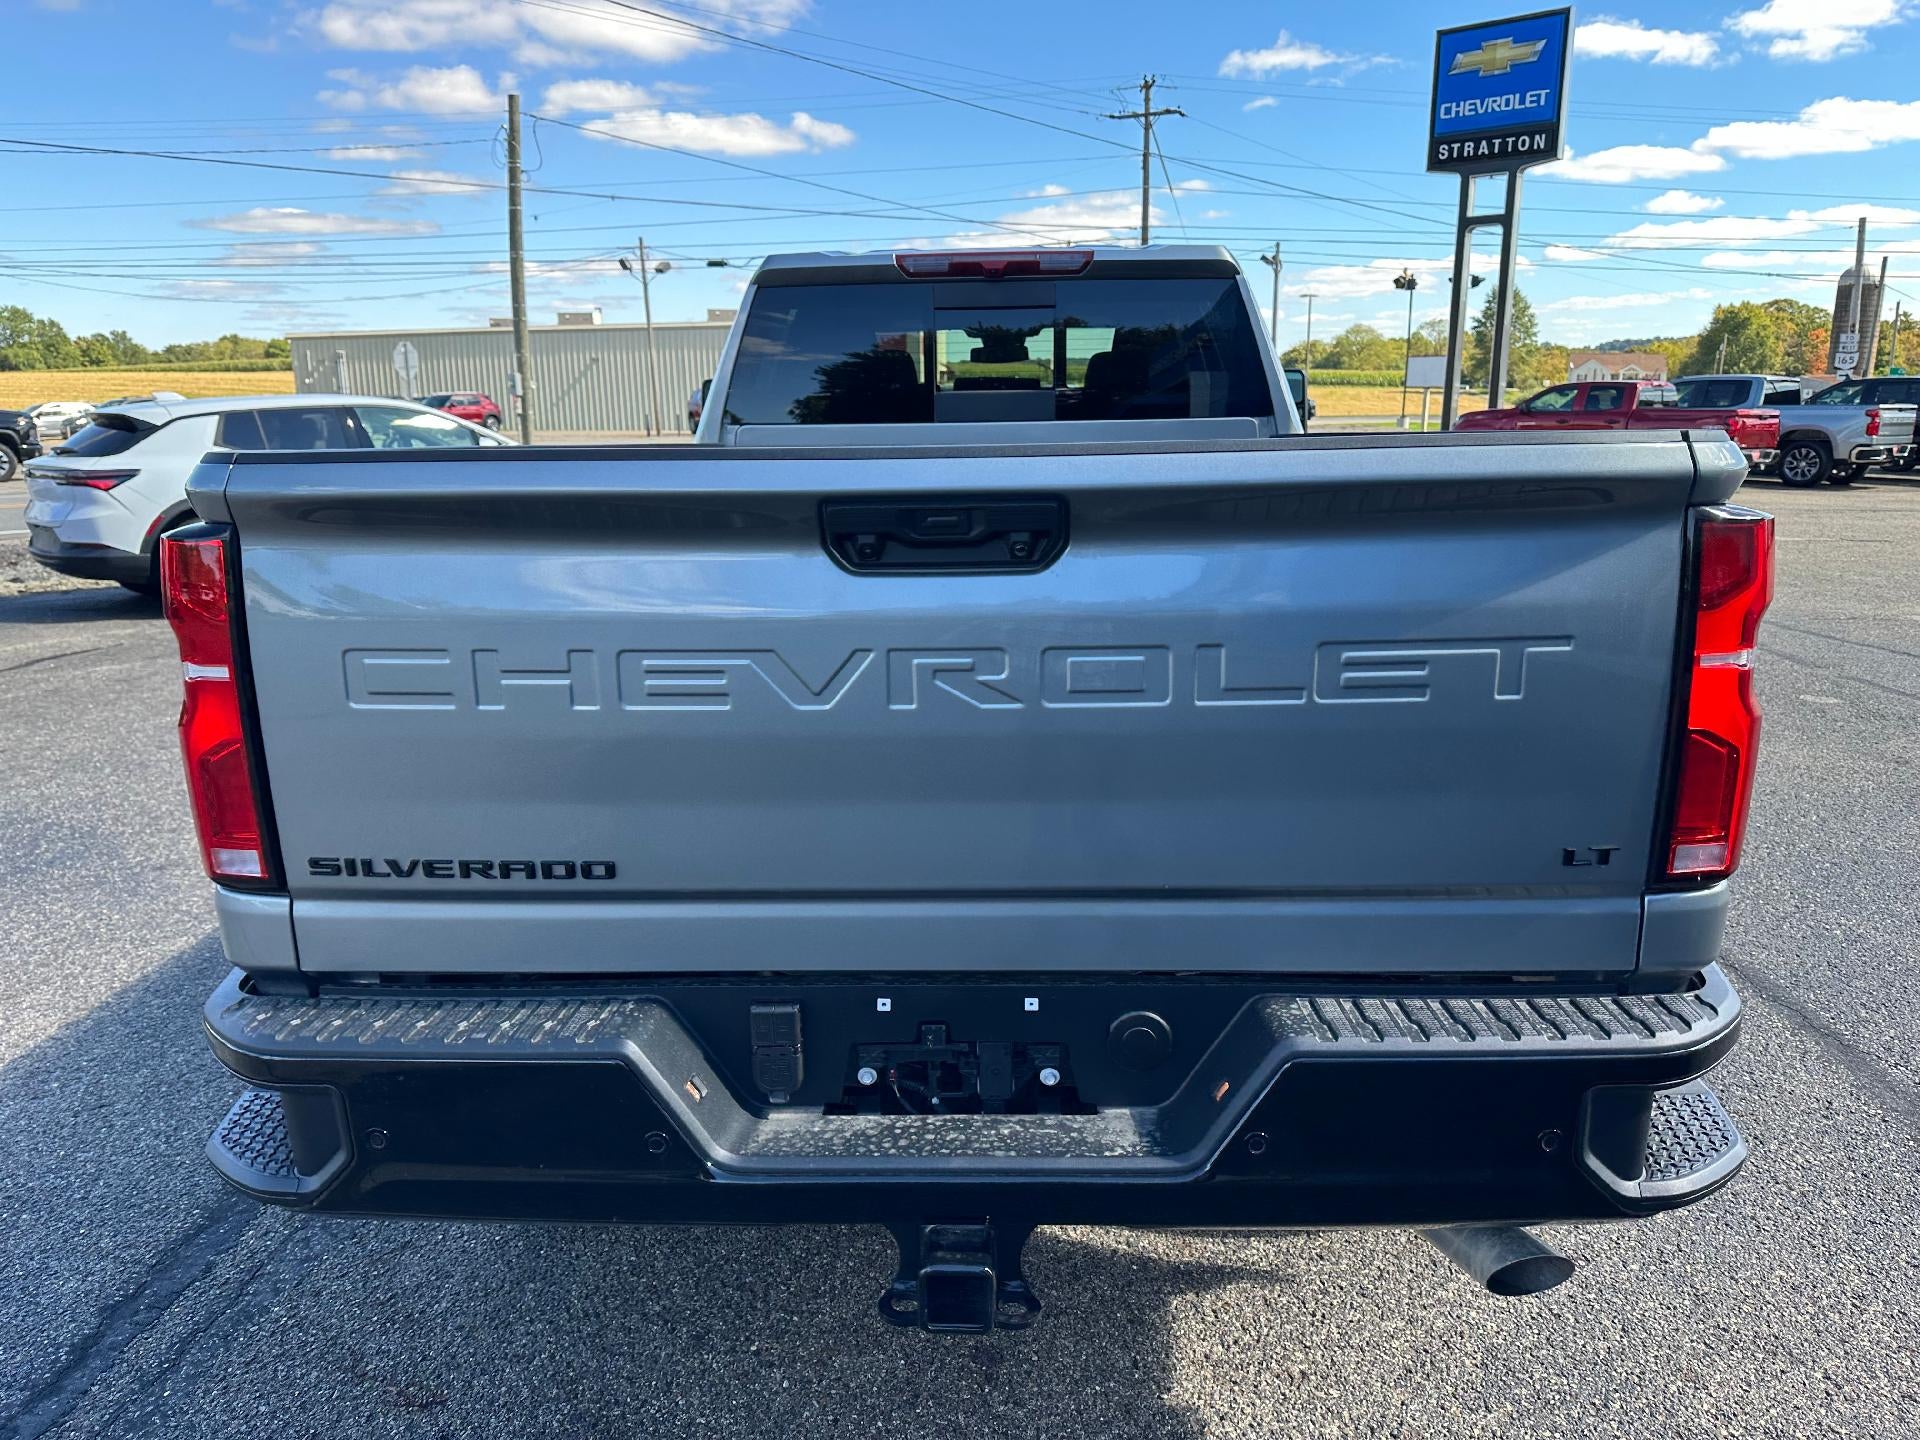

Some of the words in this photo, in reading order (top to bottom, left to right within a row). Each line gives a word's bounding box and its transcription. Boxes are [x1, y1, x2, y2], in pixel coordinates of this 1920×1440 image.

[1439, 89, 1550, 120] CHEVROLET
[1438, 133, 1547, 160] STRATTON
[1837, 356, 1856, 365] 165
[341, 635, 1576, 711] CHEVROLET
[307, 856, 617, 880] SILVERADO
[1562, 846, 1621, 866] LT
